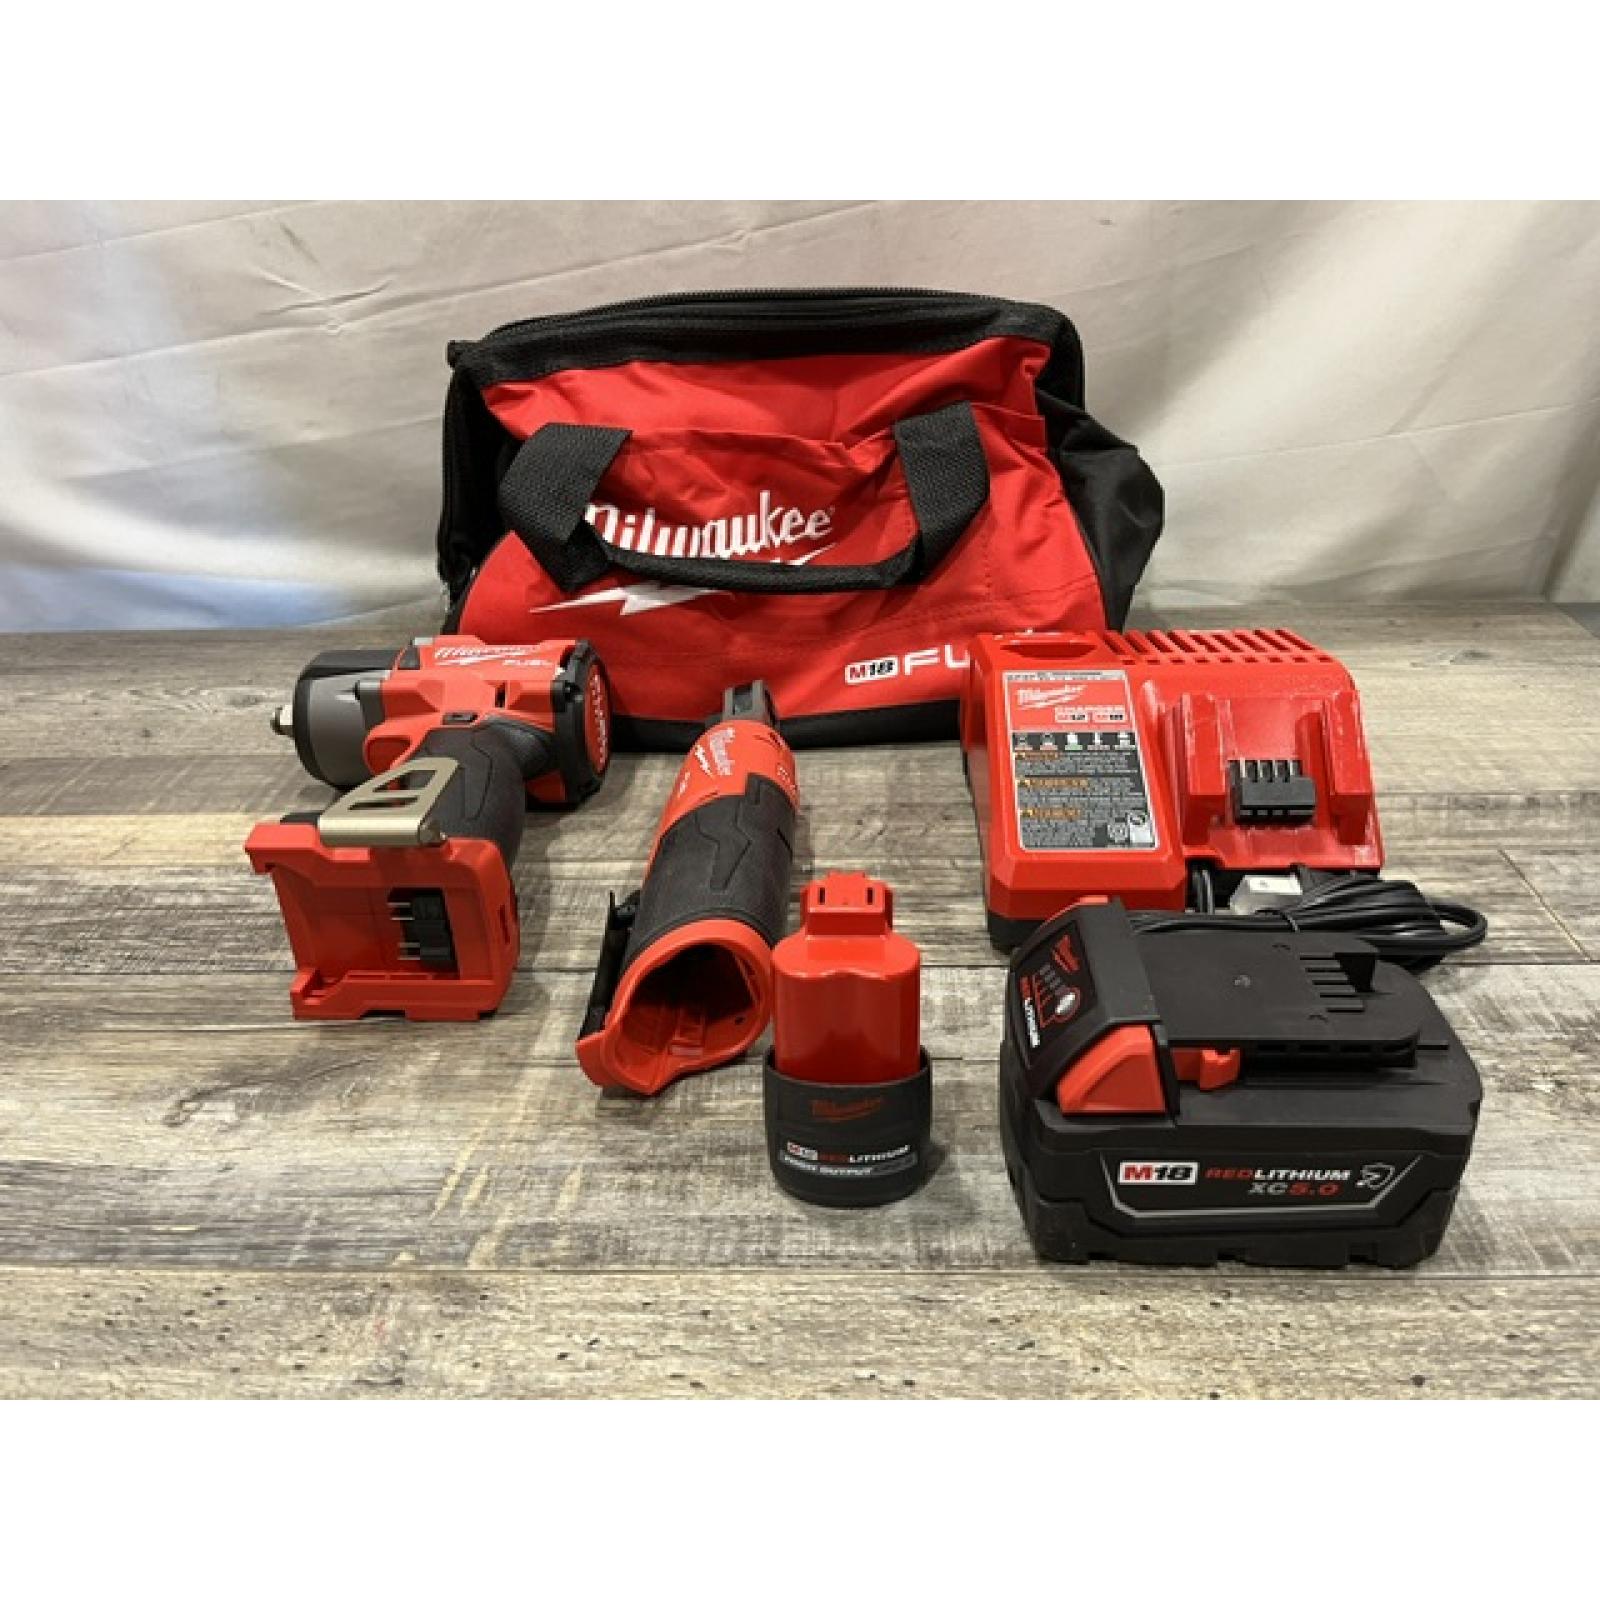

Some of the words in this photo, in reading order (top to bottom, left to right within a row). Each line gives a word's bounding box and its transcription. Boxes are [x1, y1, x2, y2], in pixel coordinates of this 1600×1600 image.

[847, 658, 897, 683] M18
[904, 644, 970, 676] FU
[1121, 1163, 1196, 1184] M18
[1204, 1167, 1352, 1182] REDLITHIUM
